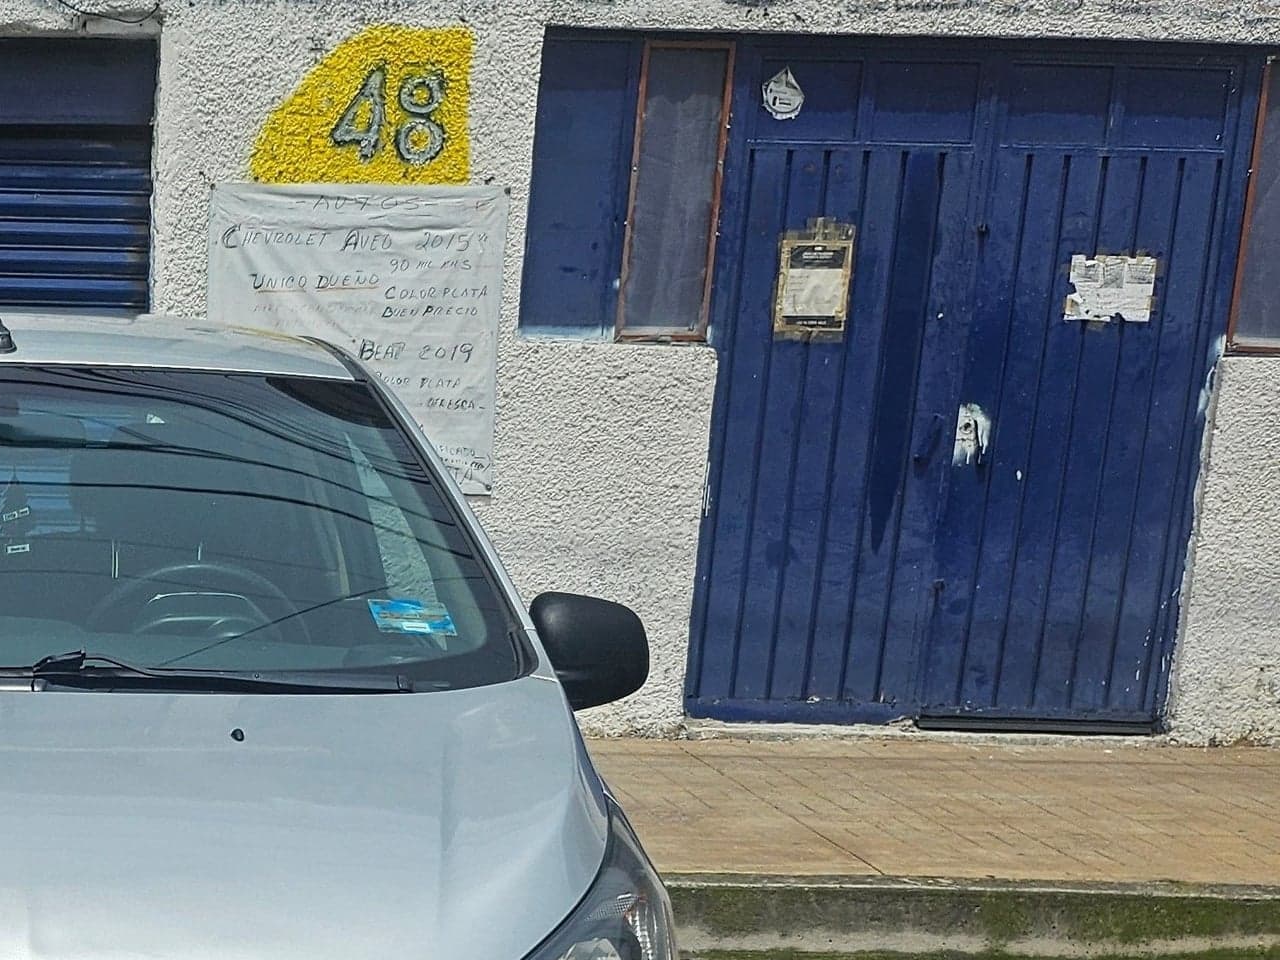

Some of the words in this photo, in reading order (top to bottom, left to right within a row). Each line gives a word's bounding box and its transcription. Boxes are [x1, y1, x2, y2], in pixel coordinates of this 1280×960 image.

[331, 60, 447, 164] 48
[222, 223, 331, 249] CHEVROLET
[340, 229, 392, 251] AVEO
[249, 273, 308, 290] UNICO
[384, 286, 437, 300] COLOR
[443, 286, 489, 299] PLATA
[422, 304, 478, 317] PRECIO
[418, 343, 474, 363] 2019
